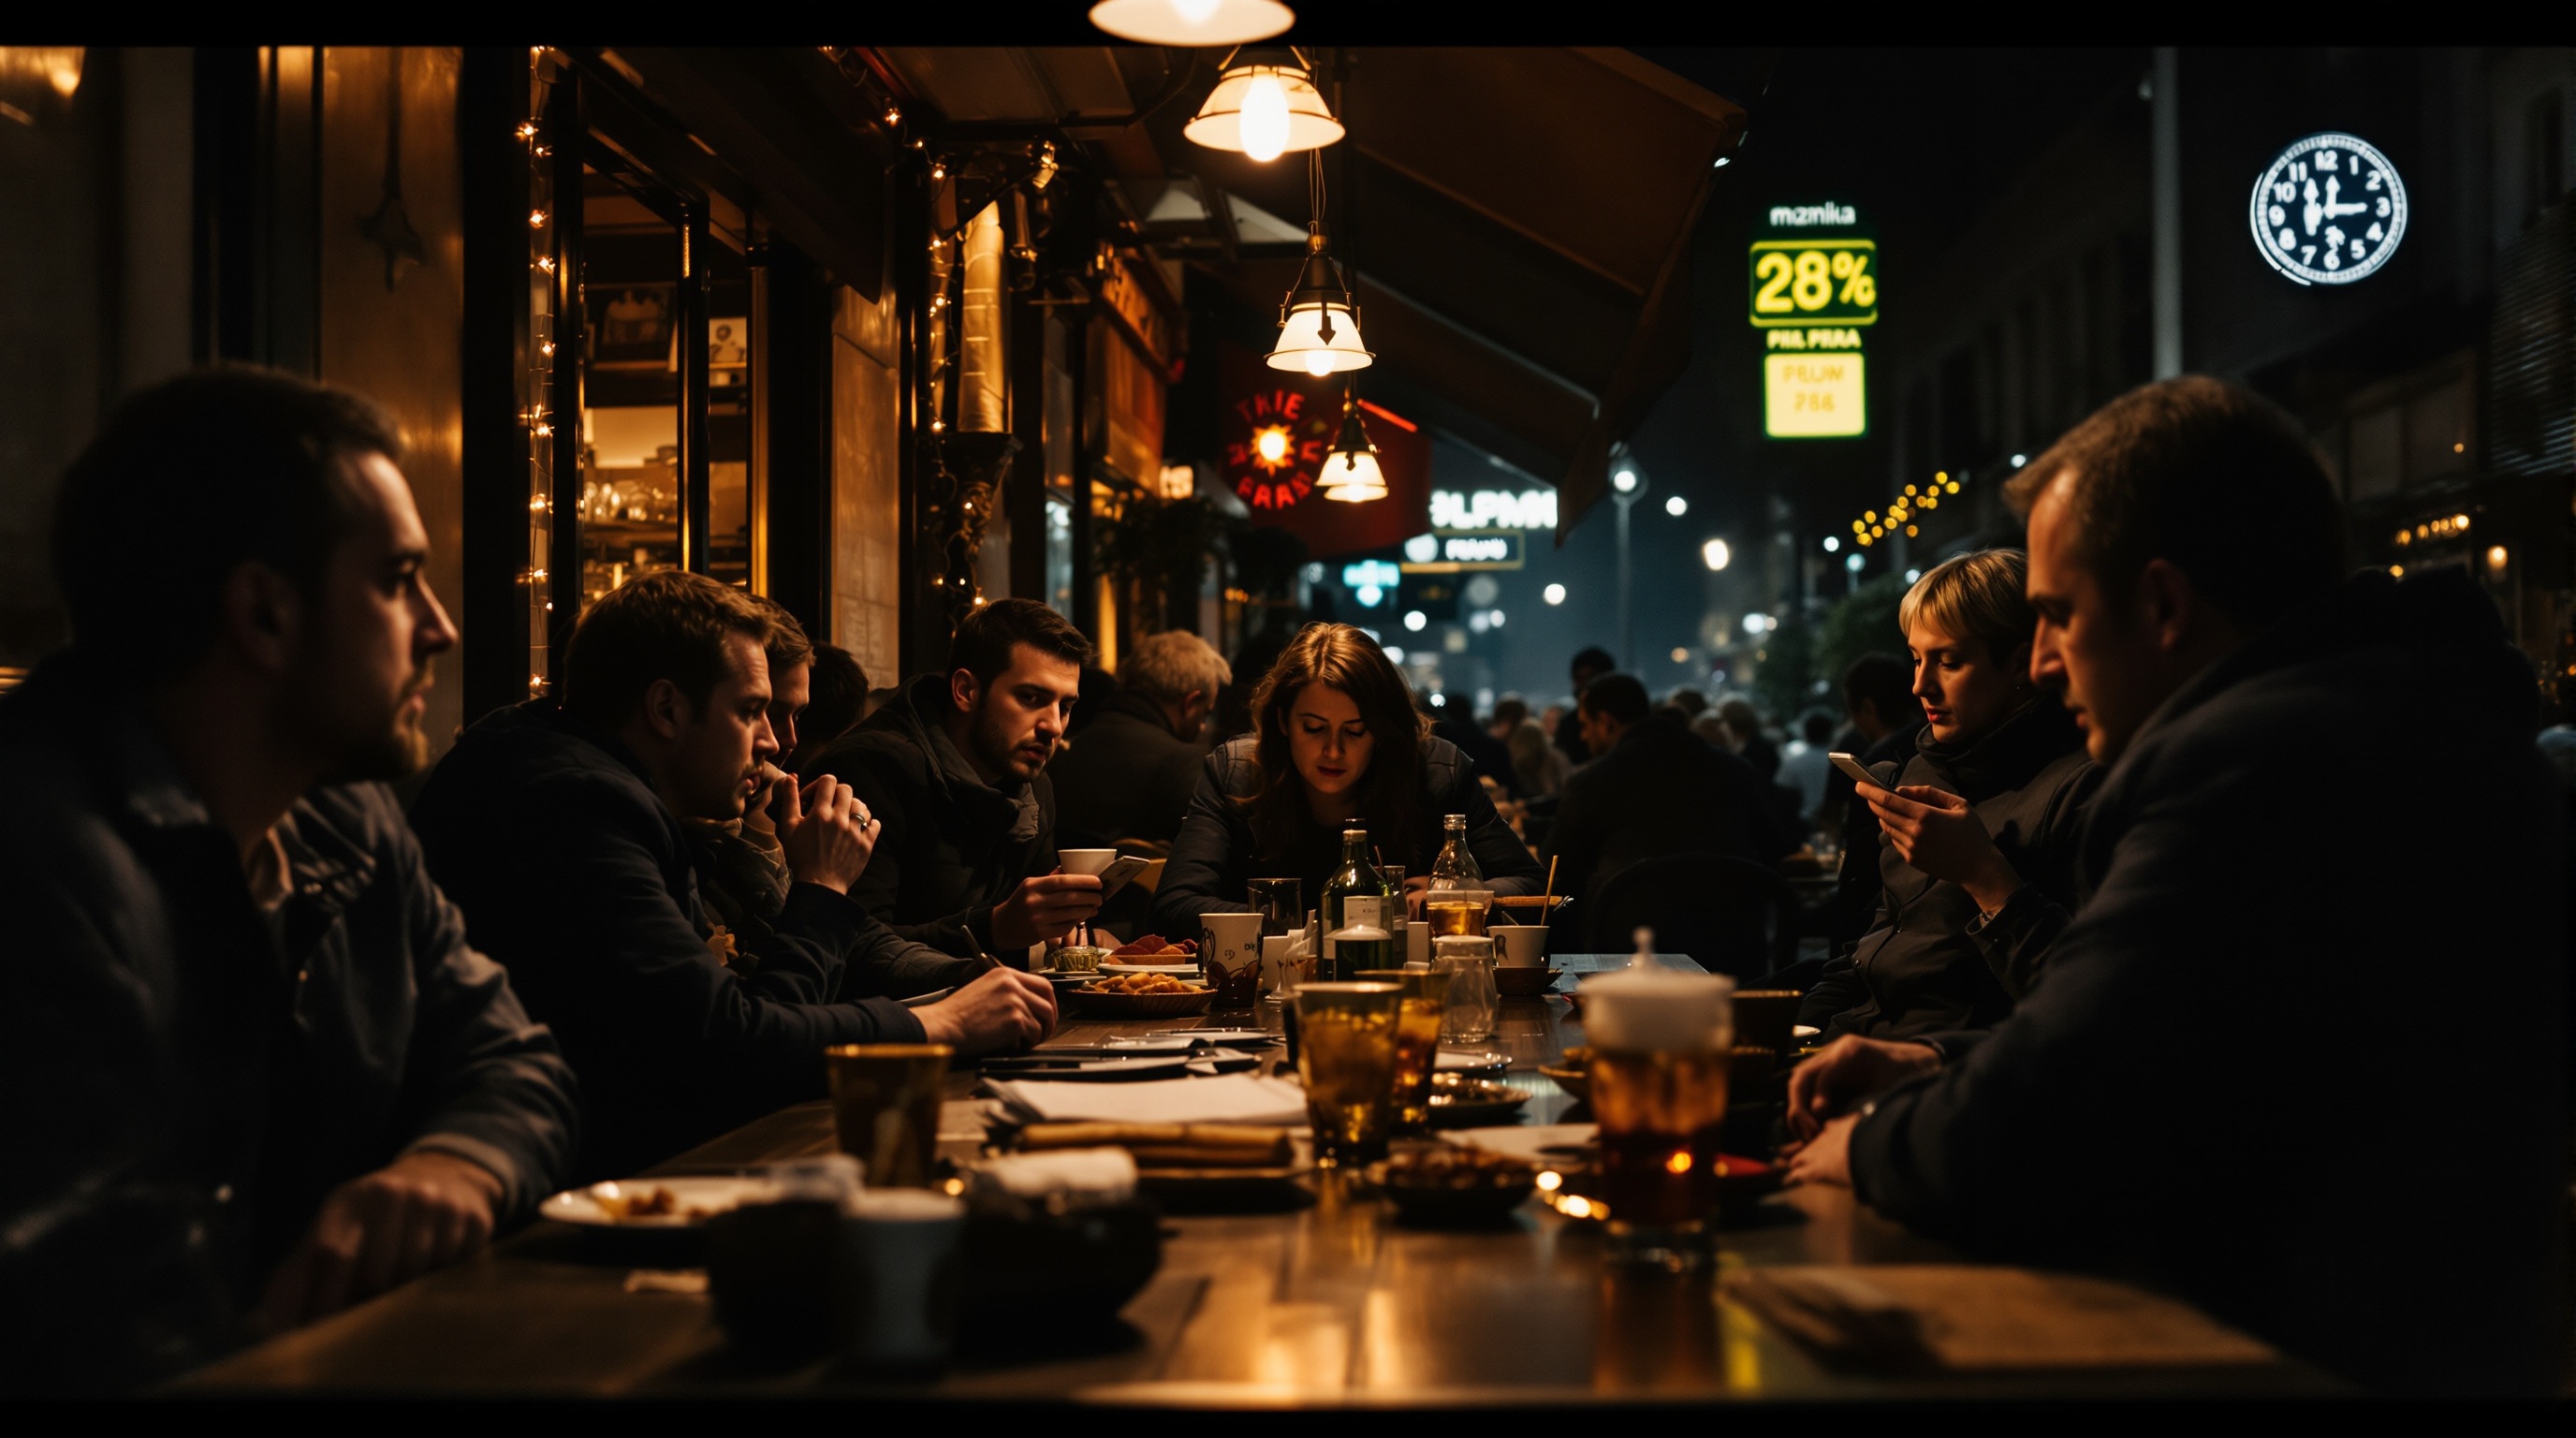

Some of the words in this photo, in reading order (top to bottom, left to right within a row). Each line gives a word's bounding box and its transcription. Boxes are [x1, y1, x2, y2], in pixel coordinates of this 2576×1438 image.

[2315, 150, 2338, 171] 12
[2349, 155, 2359, 176] 1
[2289, 161, 2307, 183] 11
[2365, 170, 2382, 191] 2
[2273, 181, 2297, 203] 10
[2268, 204, 2286, 227] 9
[2376, 197, 2391, 218] 3
[2278, 227, 2297, 251] 8
[2365, 222, 2384, 242] 4
[2301, 245, 2318, 266] 7
[2323, 249, 2340, 271] 6
[2350, 239, 2366, 260] 5
[1755, 250, 1876, 314] 28%
